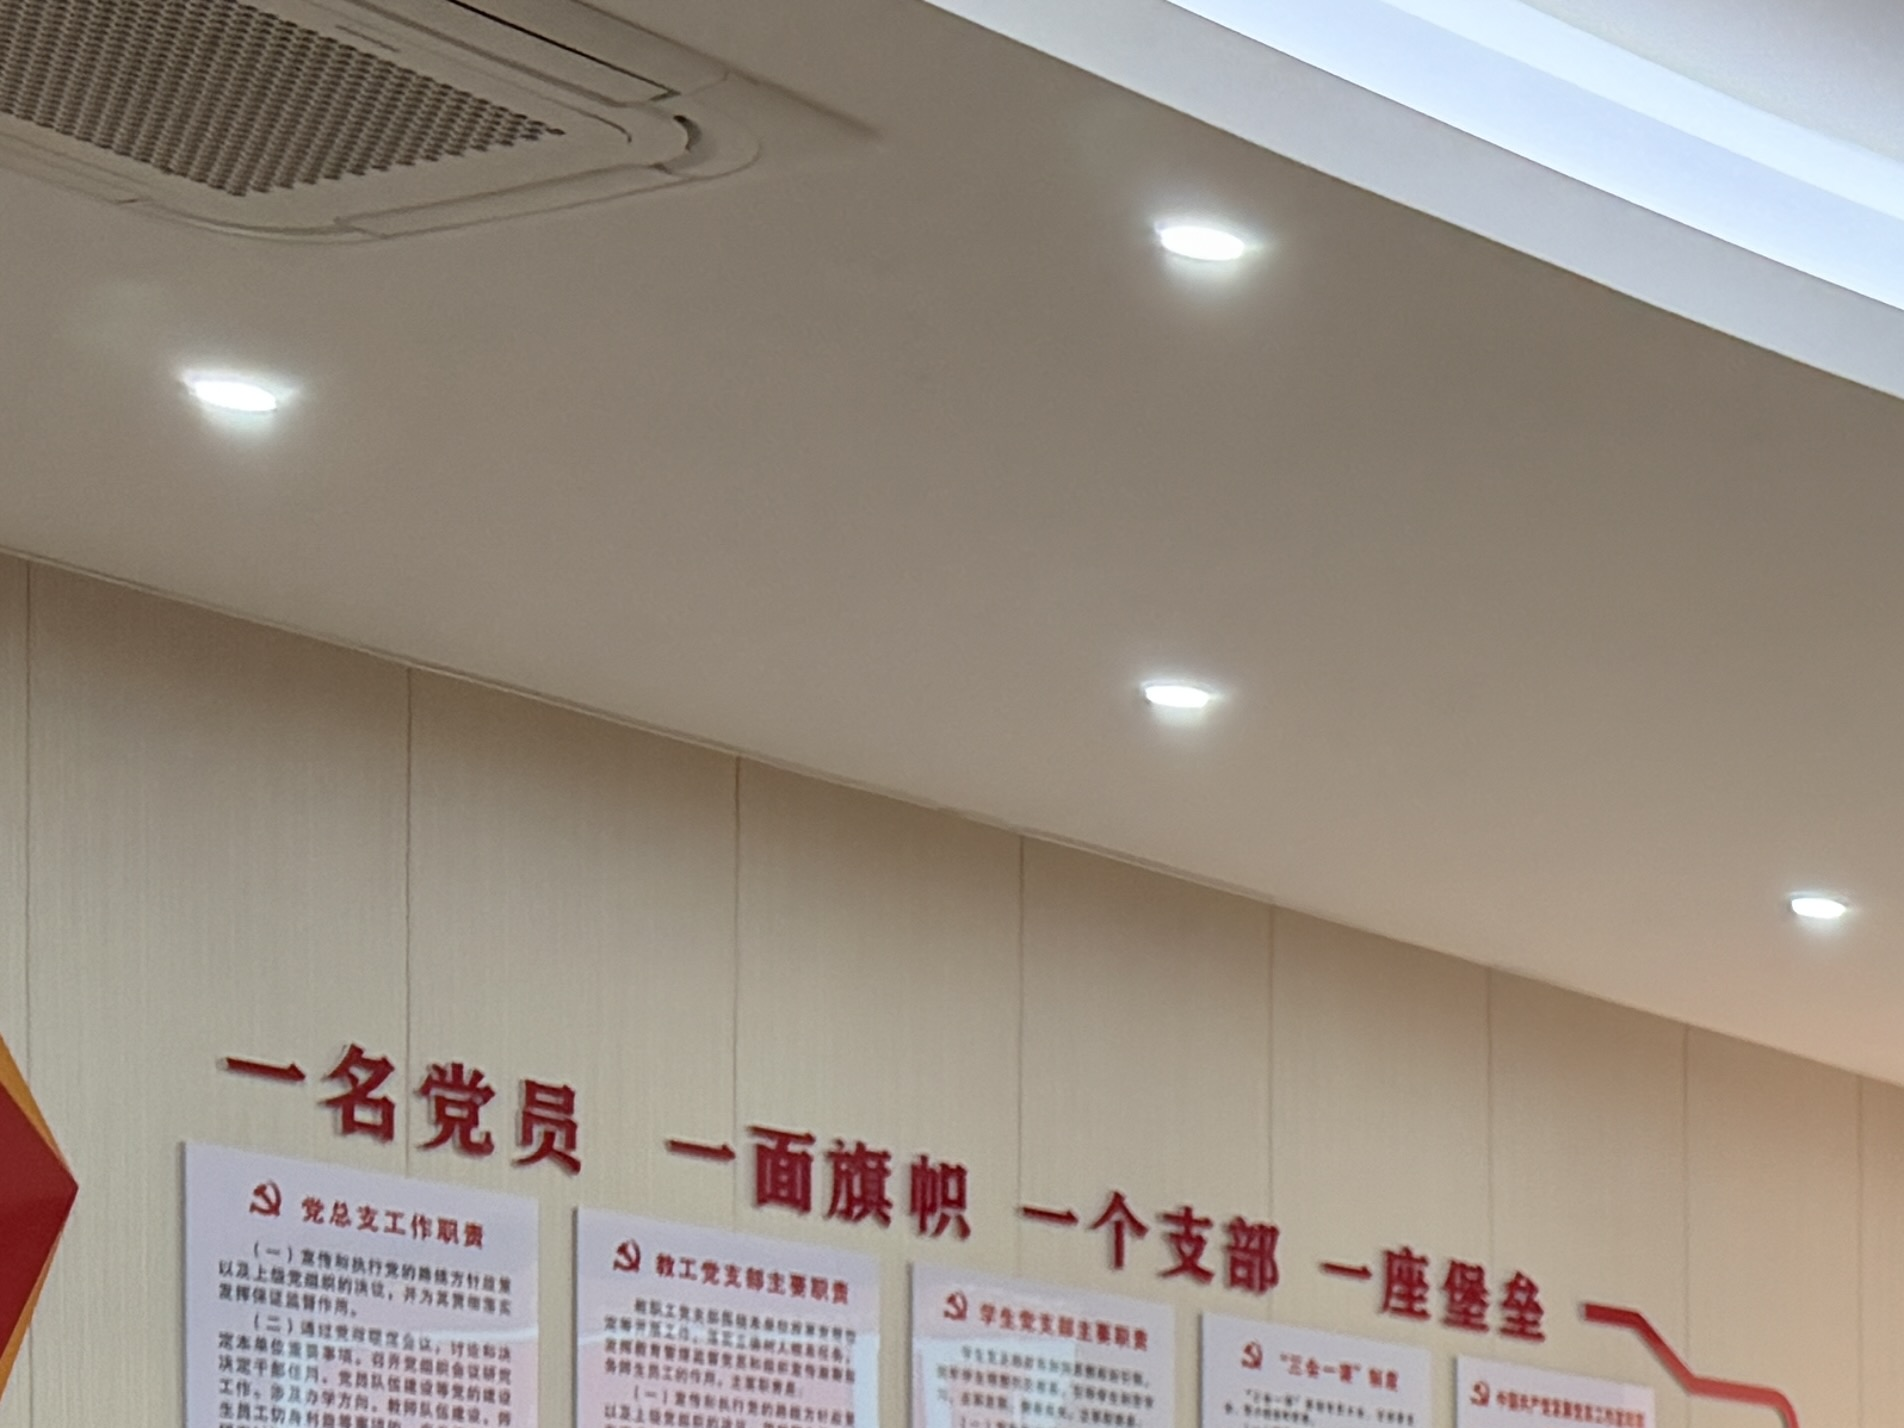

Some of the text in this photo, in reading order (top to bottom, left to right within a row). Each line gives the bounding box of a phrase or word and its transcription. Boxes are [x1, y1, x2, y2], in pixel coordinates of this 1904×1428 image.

[219, 1042, 1546, 1342] 一名党员 一面旗帜 一个支部 一座堡垒
[302, 1195, 485, 1250] 党总支工作职责
[655, 1252, 849, 1305] 教工党支部主要职责
